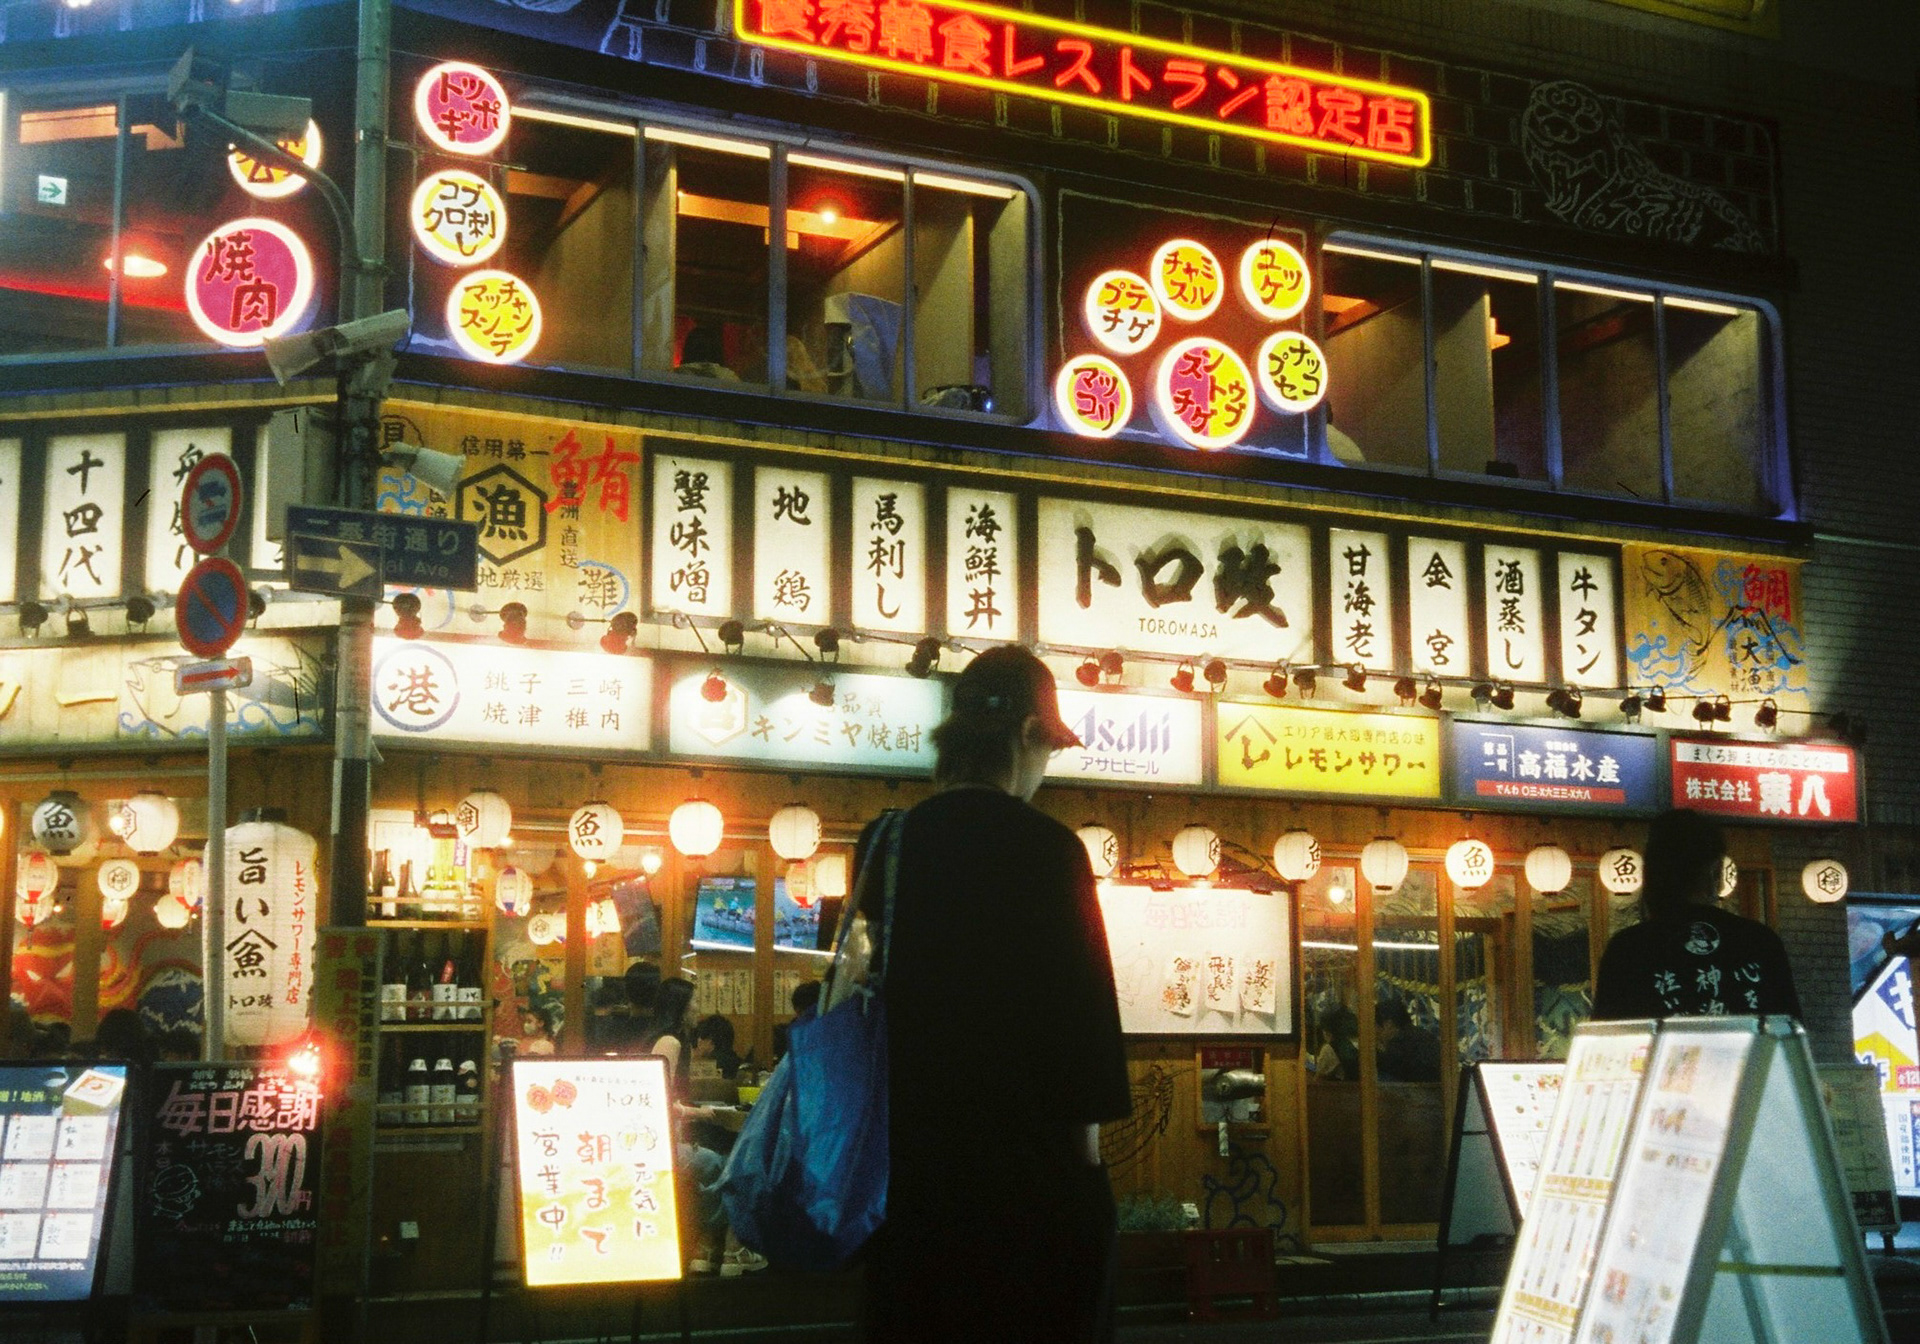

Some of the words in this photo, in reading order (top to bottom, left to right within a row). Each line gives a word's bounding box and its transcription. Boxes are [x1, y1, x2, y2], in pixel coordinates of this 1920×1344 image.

[206, 232, 277, 328] 焼肉
[59, 449, 104, 586] 十四代
[669, 468, 711, 605] 蟹味噌
[476, 566, 546, 592] 地厳選
[867, 492, 905, 620] 馬刺し
[962, 502, 1002, 631] 海鮮丼
[1343, 544, 1376, 659] 甘海老
[1495, 558, 1525, 670] 酒蒸し
[1569, 565, 1601, 675] 牛タン
[1138, 616, 1219, 640] TOROMASA
[387, 664, 440, 716] 港
[482, 701, 543, 727] 焼津
[751, 714, 922, 754] キンミヤ焼酎
[1071, 704, 1171, 755] Asahi
[1080, 756, 1161, 775] アサヒビール
[1284, 746, 1426, 776] レモンサワー
[1518, 751, 1621, 783] 高福水産
[1686, 777, 1753, 803] 株式会社
[42, 801, 74, 839] 魚
[574, 810, 603, 847] 魚
[1463, 846, 1488, 877] 魚
[1612, 854, 1639, 884] 魚
[285, 860, 306, 1005] レモンサワー専門店
[157, 1079, 325, 1137] 毎日感謝
[577, 1130, 613, 1255] 朝まで
